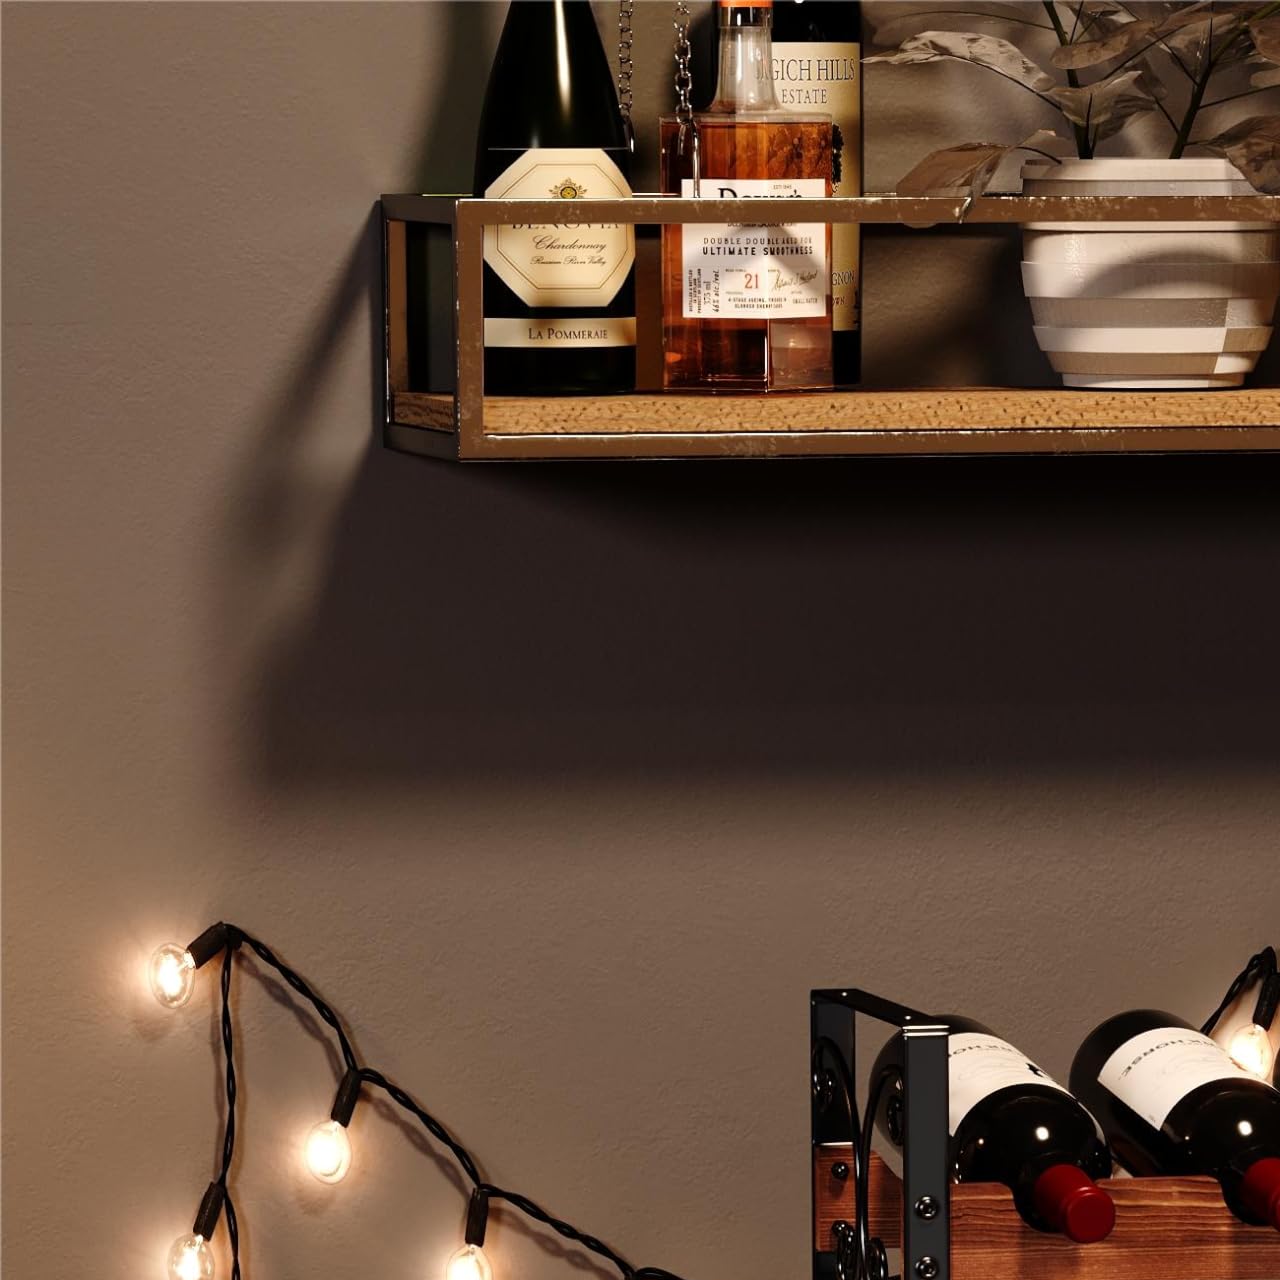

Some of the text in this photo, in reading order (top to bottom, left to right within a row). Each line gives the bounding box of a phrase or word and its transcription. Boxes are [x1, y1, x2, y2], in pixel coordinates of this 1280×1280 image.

[817, 58, 855, 81] HILLS
[781, 88, 828, 104] ESTATE
[532, 234, 607, 253] Chardonnay
[703, 237, 742, 245] DOUBLE
[702, 245, 813, 256] ULTIMATE SMOOTHNESS
[744, 273, 759, 289] 21
